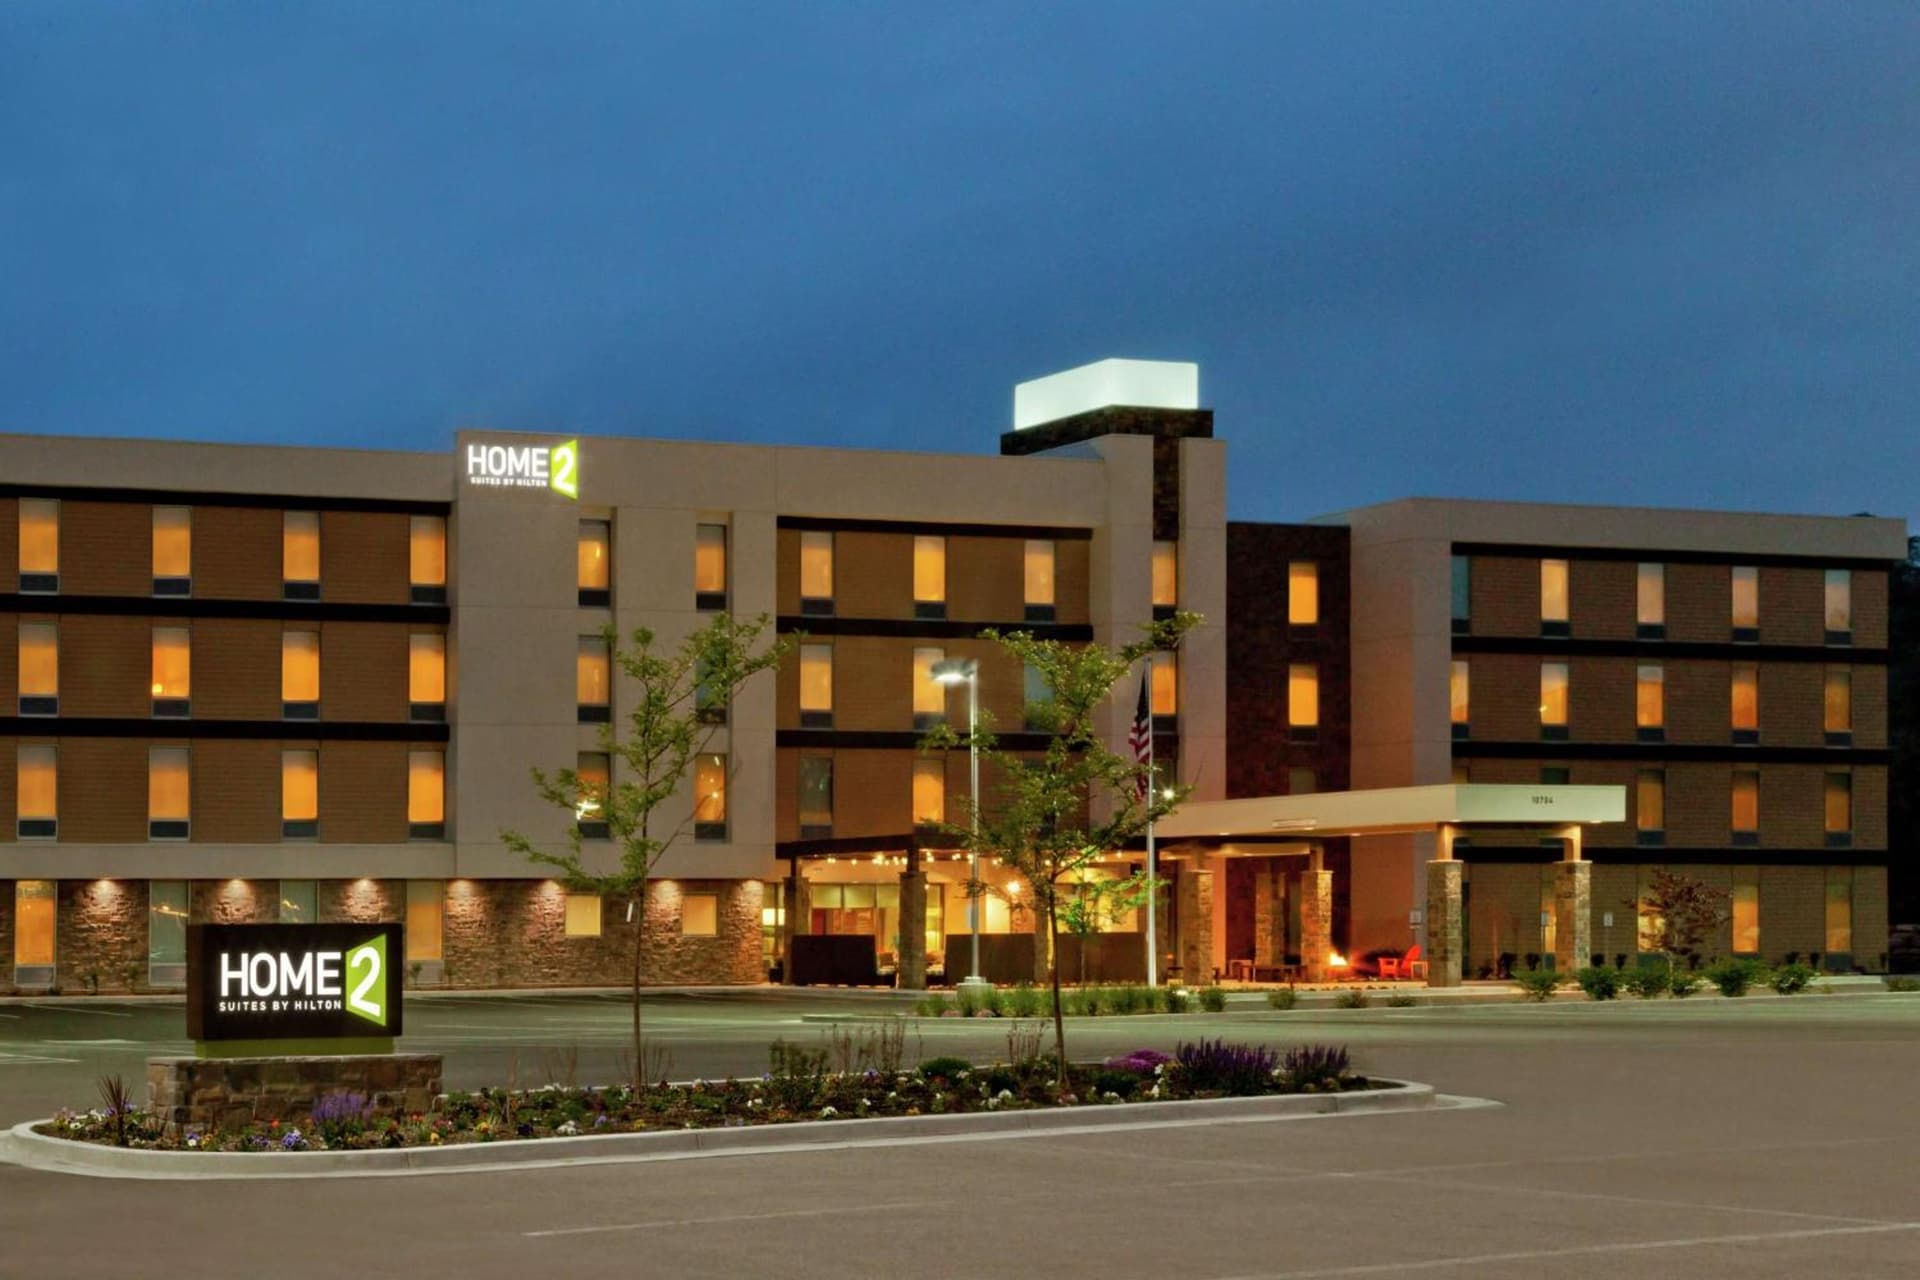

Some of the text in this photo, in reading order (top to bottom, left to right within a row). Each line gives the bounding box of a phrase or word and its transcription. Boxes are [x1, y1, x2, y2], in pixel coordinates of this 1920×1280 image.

[467, 445, 575, 494] HOME 2
[470, 477, 548, 487] SUITES BY HILTON
[220, 946, 381, 1017] HOME 2
[219, 1000, 342, 1012] SUITES BY HILTON
